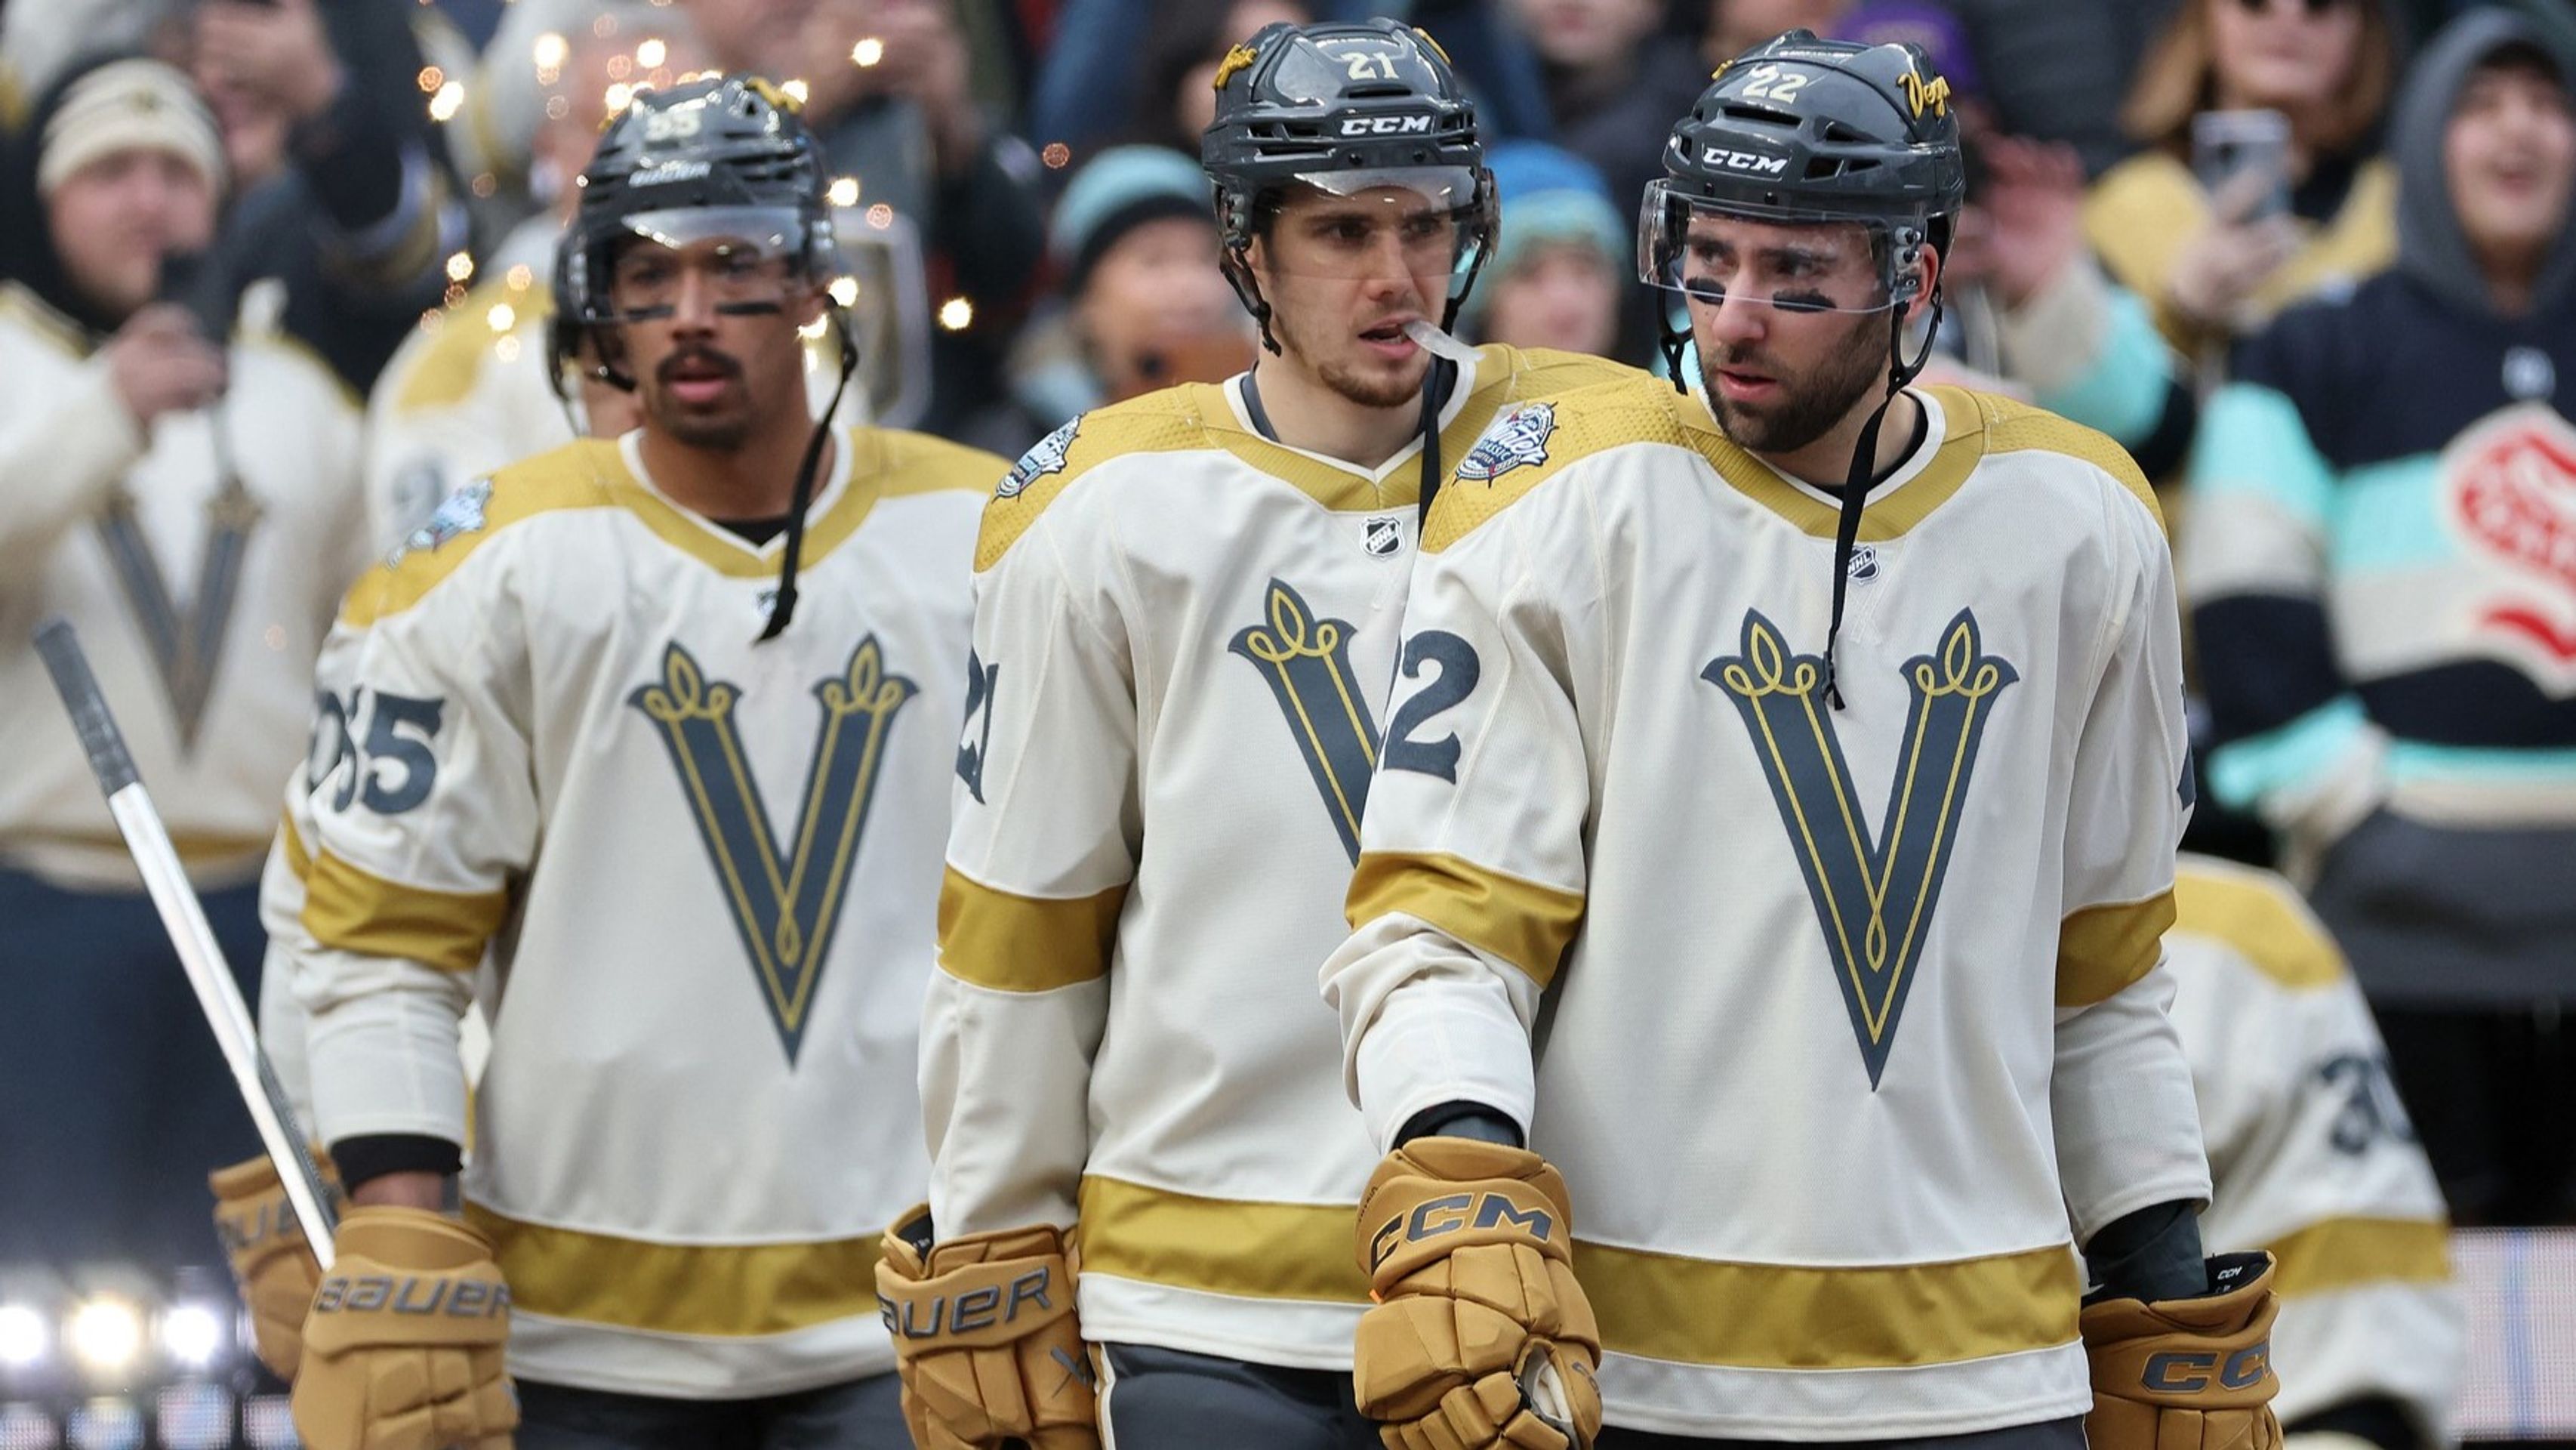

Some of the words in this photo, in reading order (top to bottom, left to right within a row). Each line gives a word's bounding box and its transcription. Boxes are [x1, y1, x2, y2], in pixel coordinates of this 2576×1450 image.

[1340, 51, 1400, 81] 21
[1742, 69, 1808, 104] 22
[1340, 115, 1432, 137] CCM
[1702, 147, 1792, 174] CCM
[1369, 526, 1396, 552] NHL
[1847, 553, 1872, 575] NHL
[1374, 629, 1481, 785] 2
[626, 631, 920, 1074] V
[1700, 606, 2020, 1093] V
[1370, 1192, 1553, 1276] CCM
[876, 1266, 1052, 1339] AUER
[2140, 1340, 2272, 1394] CC
